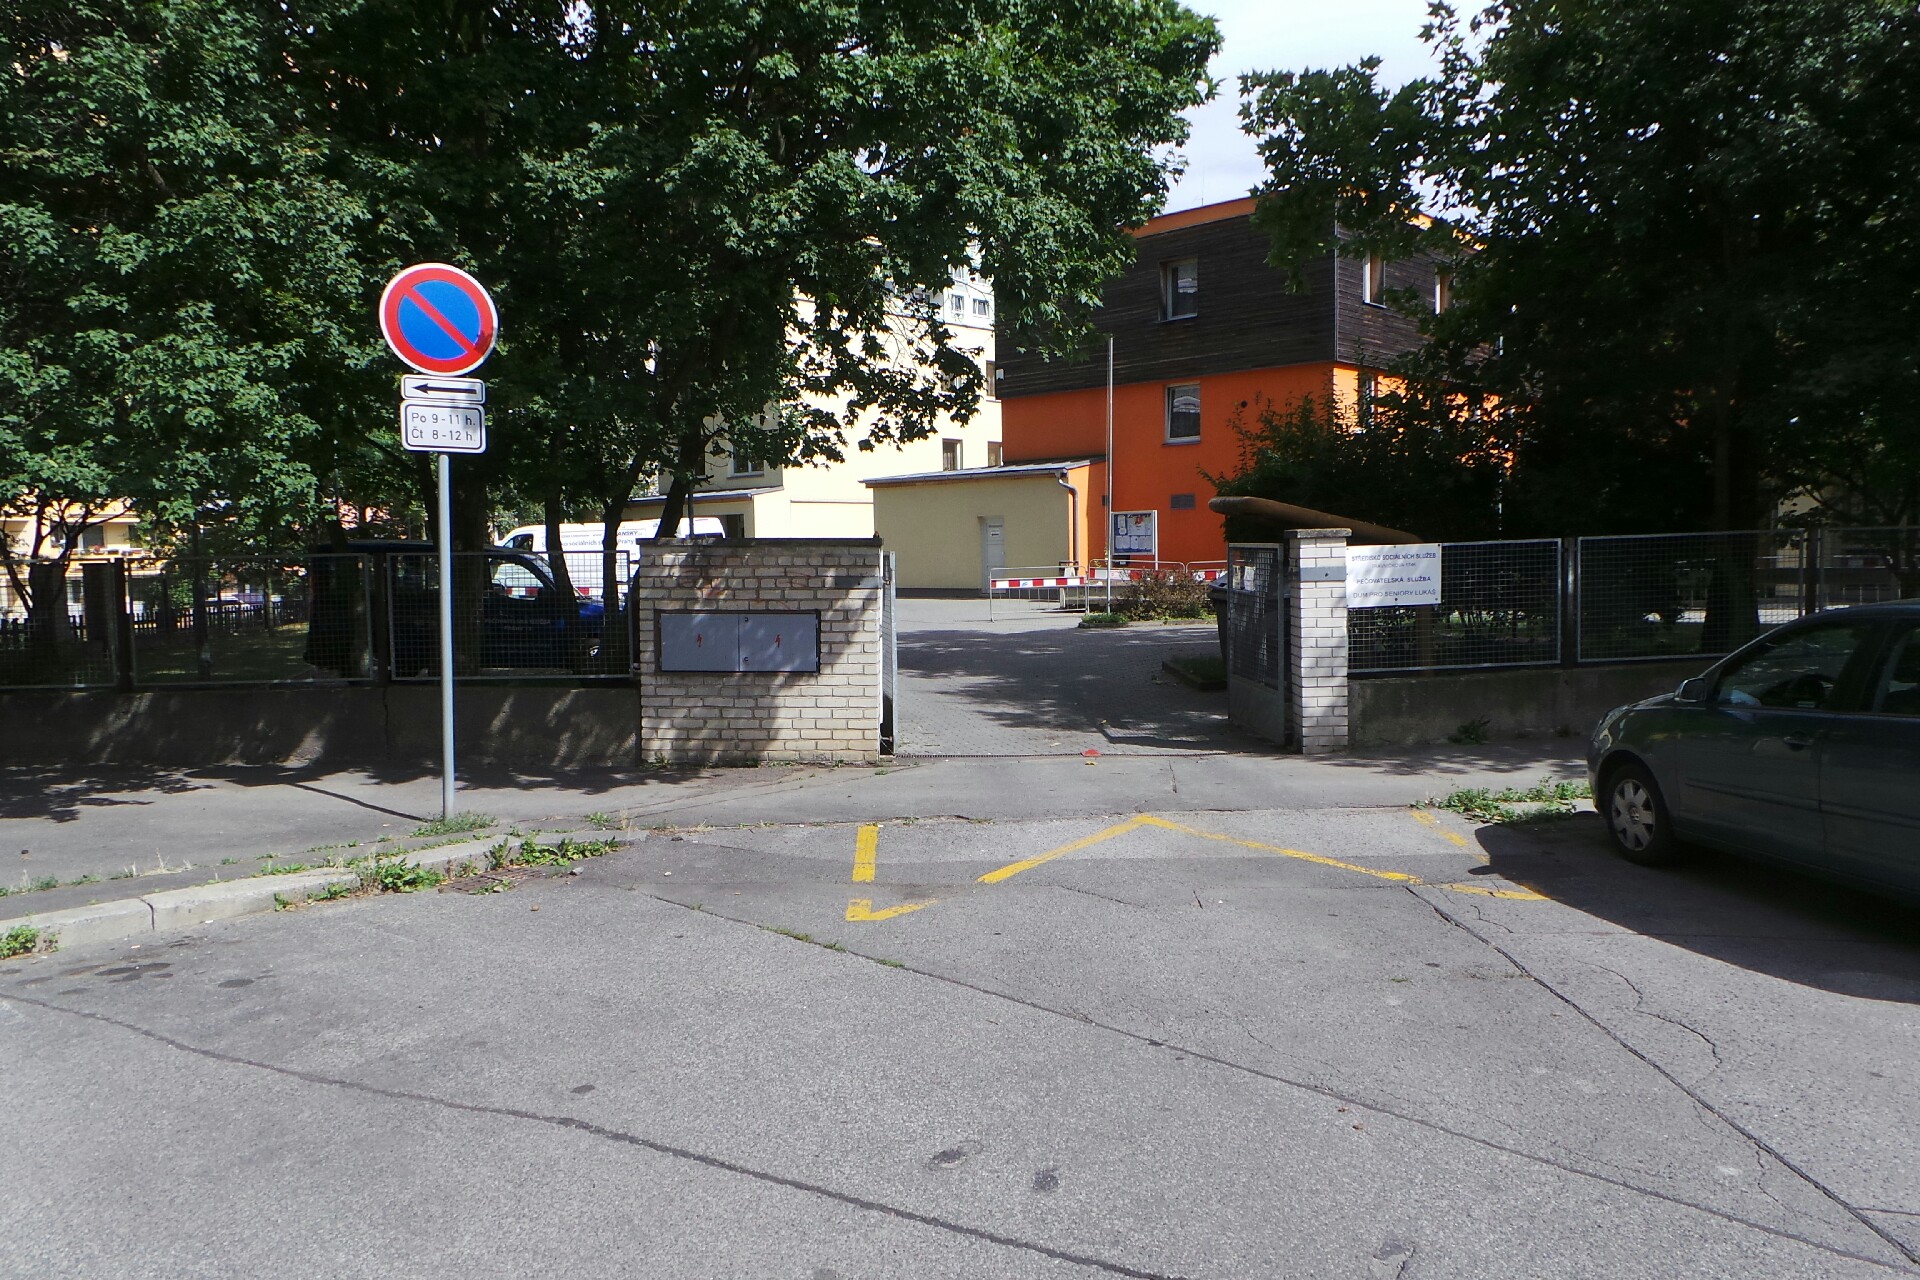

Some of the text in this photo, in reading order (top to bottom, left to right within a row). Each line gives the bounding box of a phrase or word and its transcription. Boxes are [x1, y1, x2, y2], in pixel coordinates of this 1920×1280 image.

[411, 412, 427, 423] Po
[465, 414, 476, 426] h.
[411, 426, 424, 439] Čt
[465, 431, 476, 442] h.
[1382, 552, 1415, 561] SOCIÁLNÍCH
